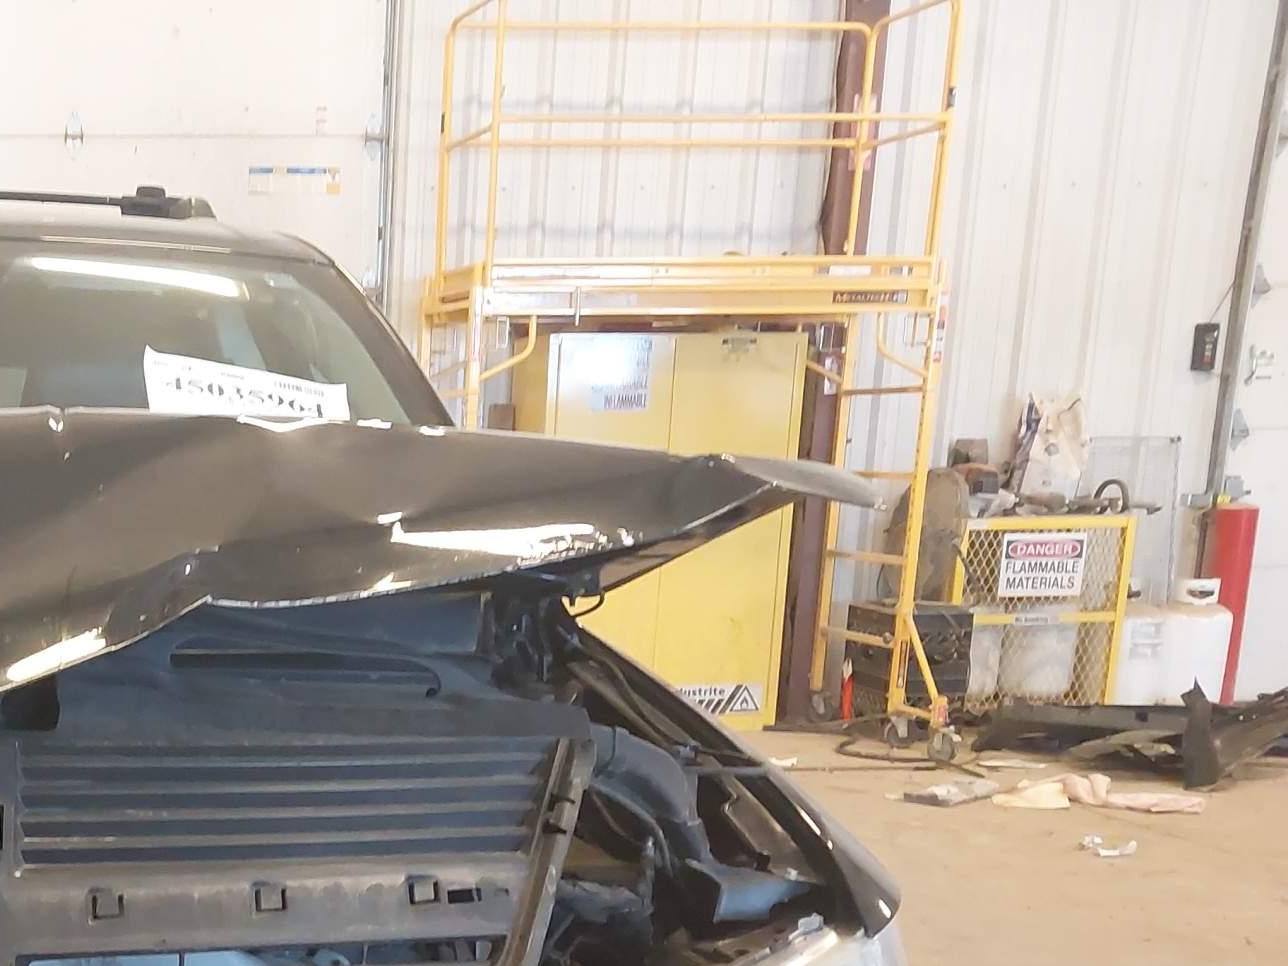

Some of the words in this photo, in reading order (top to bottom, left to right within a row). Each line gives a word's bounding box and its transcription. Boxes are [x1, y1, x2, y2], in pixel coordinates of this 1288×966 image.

[1016, 543, 1073, 556] DANGER
[1005, 560, 1080, 575] FLAMMABLE
[1005, 576, 1076, 591] MATERIALS
